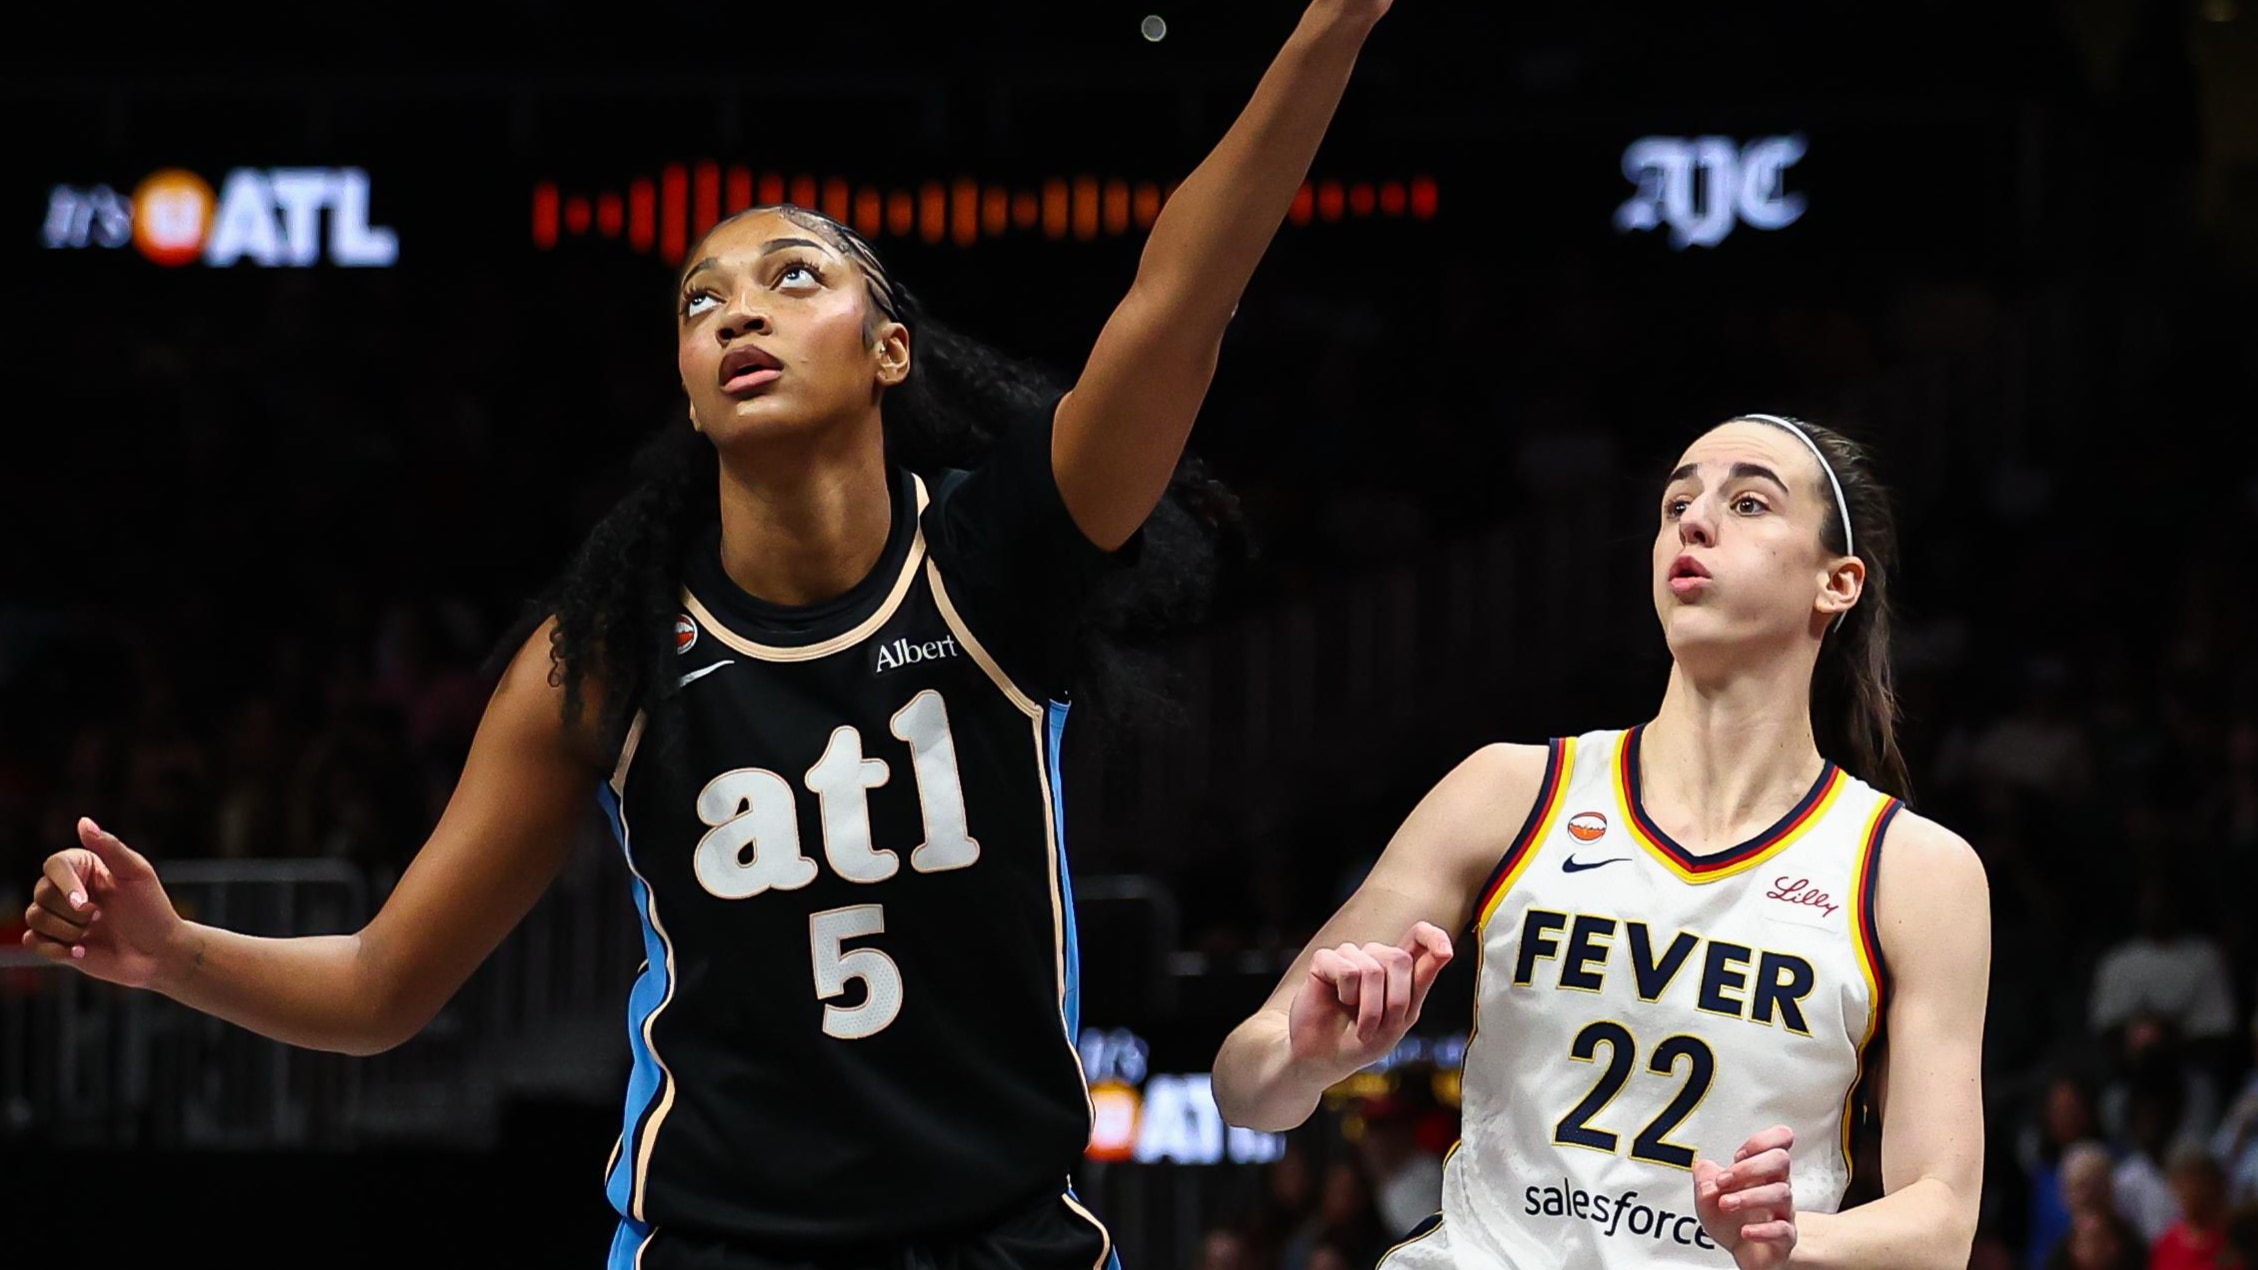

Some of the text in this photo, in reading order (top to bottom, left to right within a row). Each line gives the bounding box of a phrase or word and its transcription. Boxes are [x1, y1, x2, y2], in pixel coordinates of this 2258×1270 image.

[208, 166, 399, 267] ATL
[1613, 133, 1807, 248] AJC
[875, 634, 957, 673] Albert
[694, 689, 980, 900] atl
[1766, 875, 1840, 918] Lilly
[809, 904, 903, 1039] 5
[1513, 908, 1815, 1038] FEVER
[1552, 1019, 1719, 1172] 22
